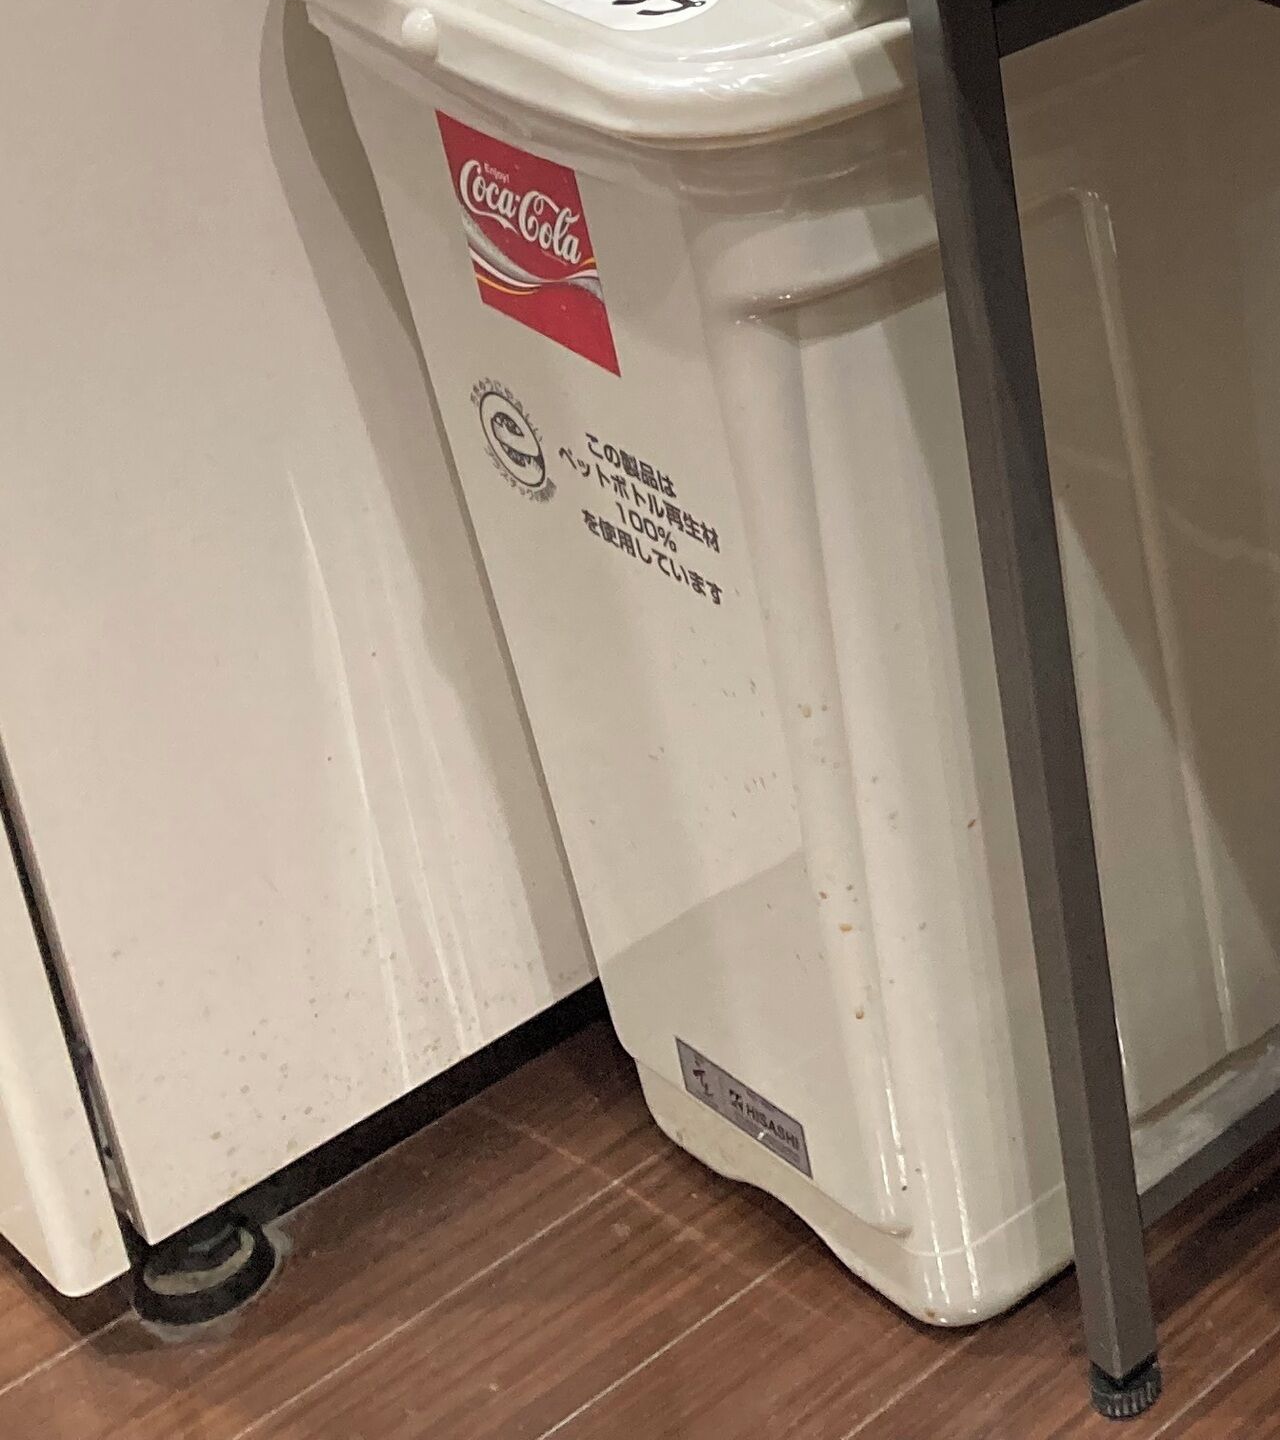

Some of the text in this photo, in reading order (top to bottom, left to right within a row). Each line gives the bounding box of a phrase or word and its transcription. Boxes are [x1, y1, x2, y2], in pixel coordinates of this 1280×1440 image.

[460, 159, 582, 265] Coca-Cola
[558, 447, 720, 553] ペットボトル再生材
[585, 432, 677, 498] この製品は
[581, 509, 723, 605] を使用しています
[615, 502, 677, 553] 100%
